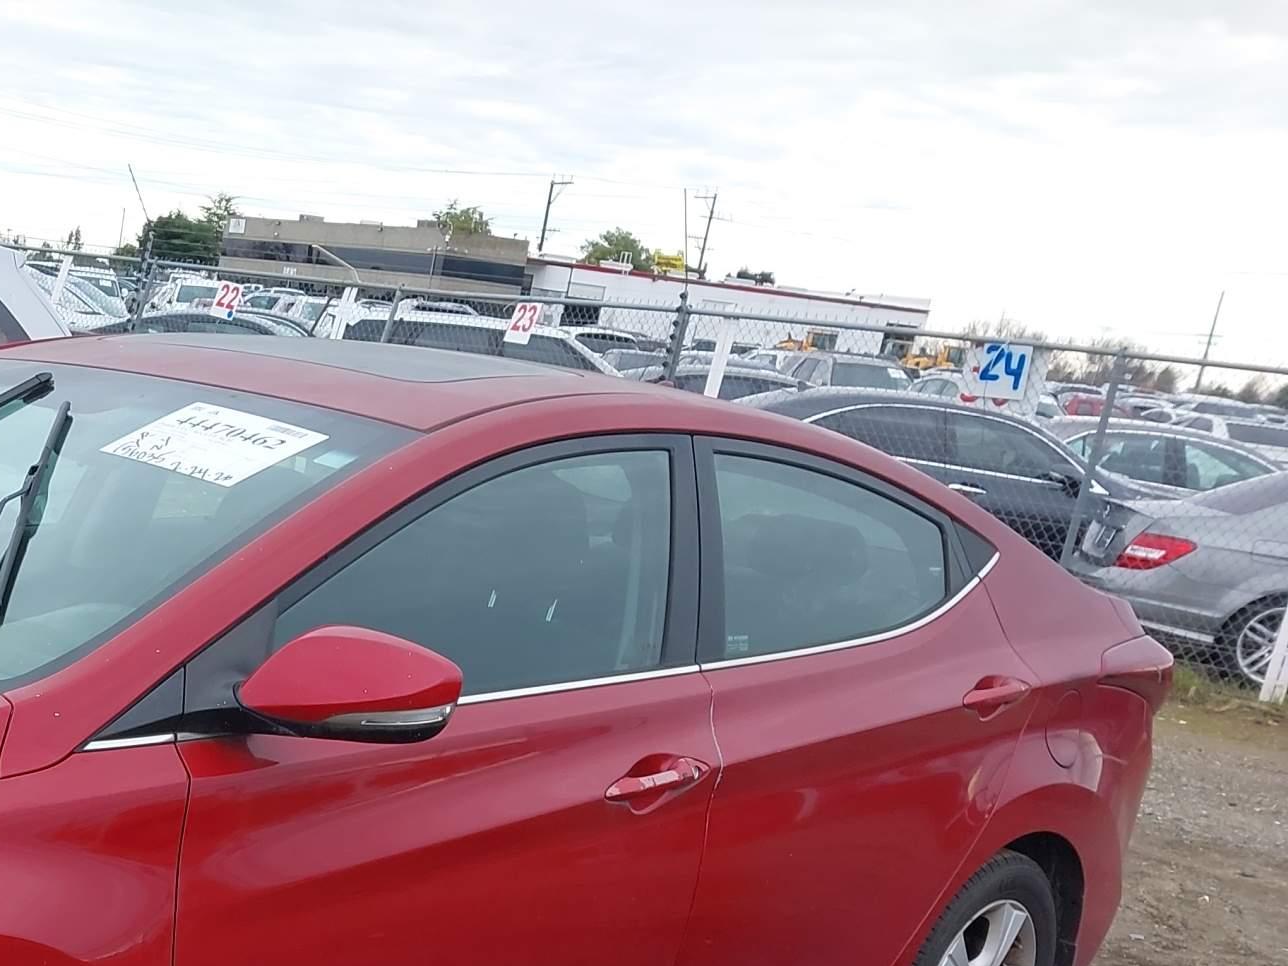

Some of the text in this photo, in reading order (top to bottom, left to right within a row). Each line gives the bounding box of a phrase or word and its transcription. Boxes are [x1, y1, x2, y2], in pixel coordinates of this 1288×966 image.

[216, 284, 240, 309] 22
[511, 305, 538, 332] 23
[979, 343, 1026, 390] 24
[176, 416, 287, 450] 44470462
